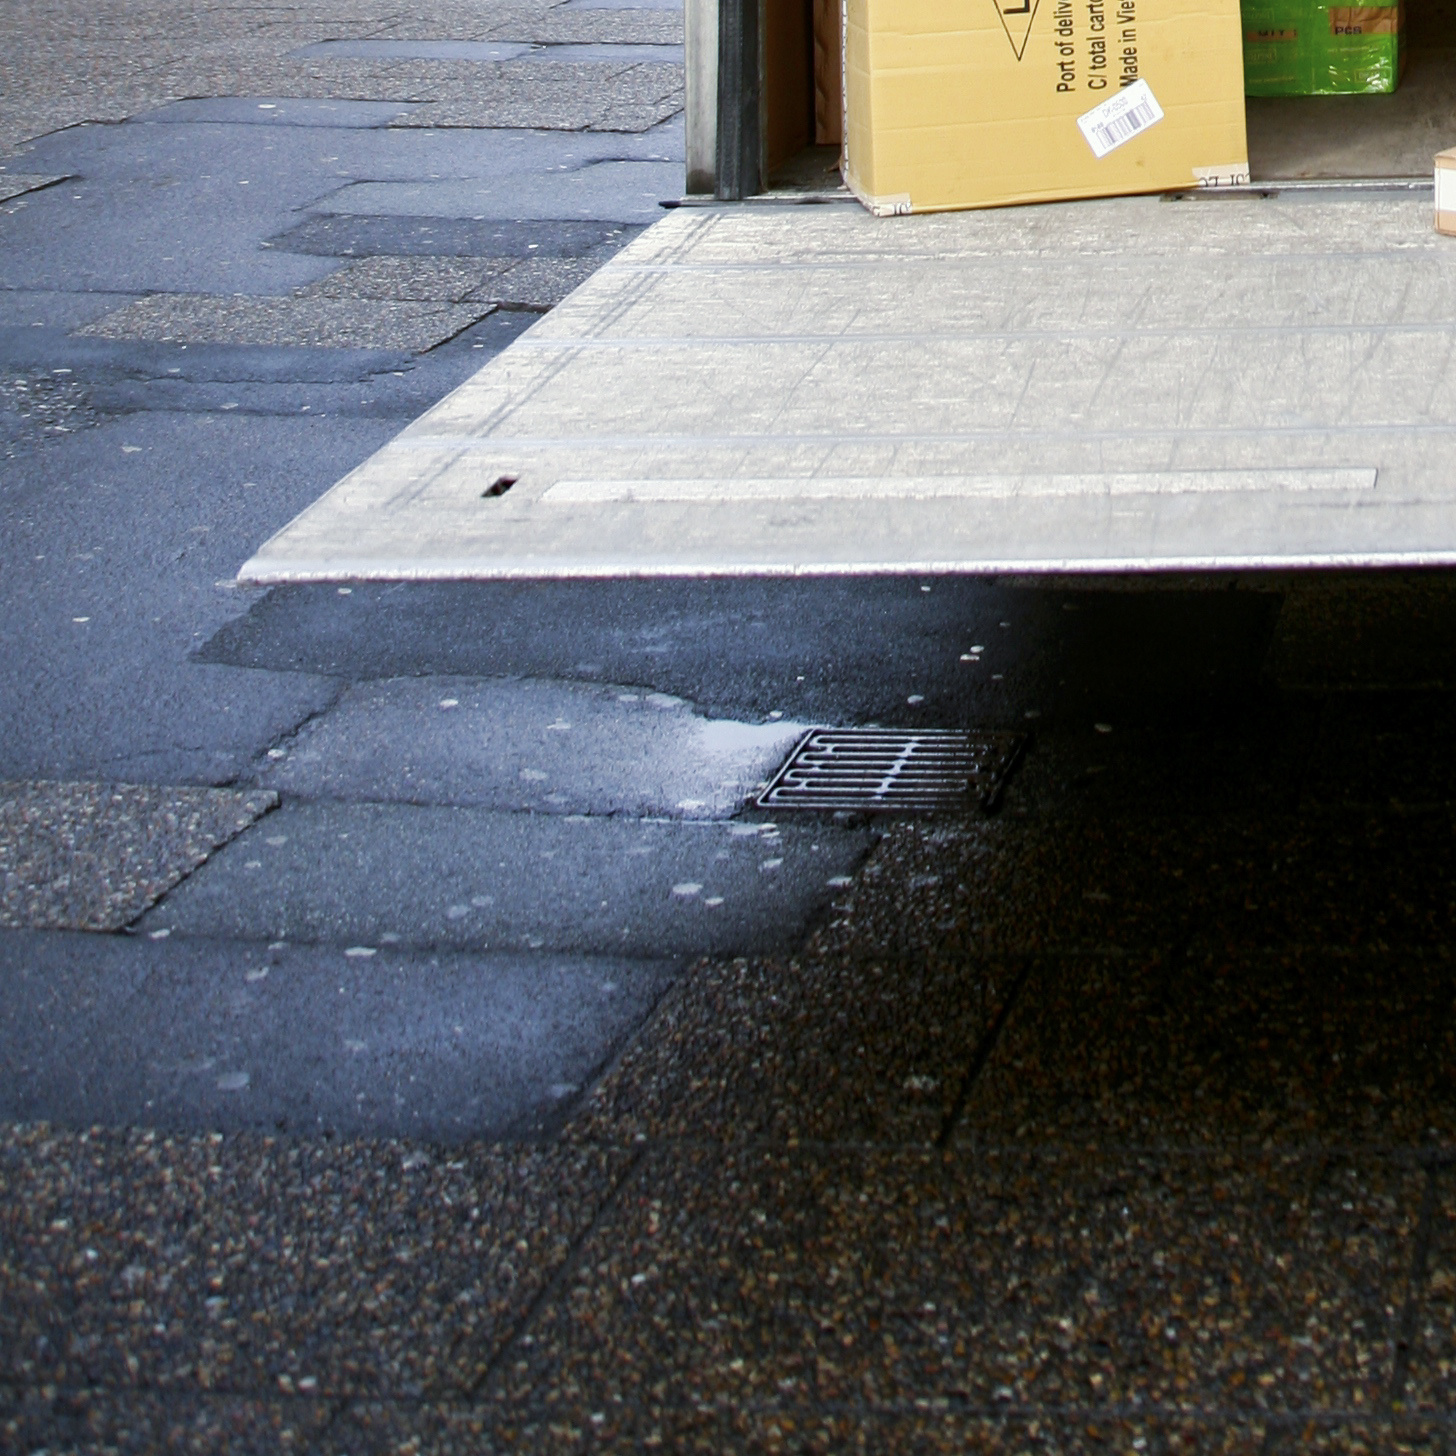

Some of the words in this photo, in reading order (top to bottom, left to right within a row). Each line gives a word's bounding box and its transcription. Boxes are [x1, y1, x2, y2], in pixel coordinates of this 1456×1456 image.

[1054, 41, 1075, 57] of
[1118, 28, 1137, 43] in
[1086, 36, 1107, 71] total
[1118, 47, 1138, 87] Made
[1056, 60, 1076, 93] Port
